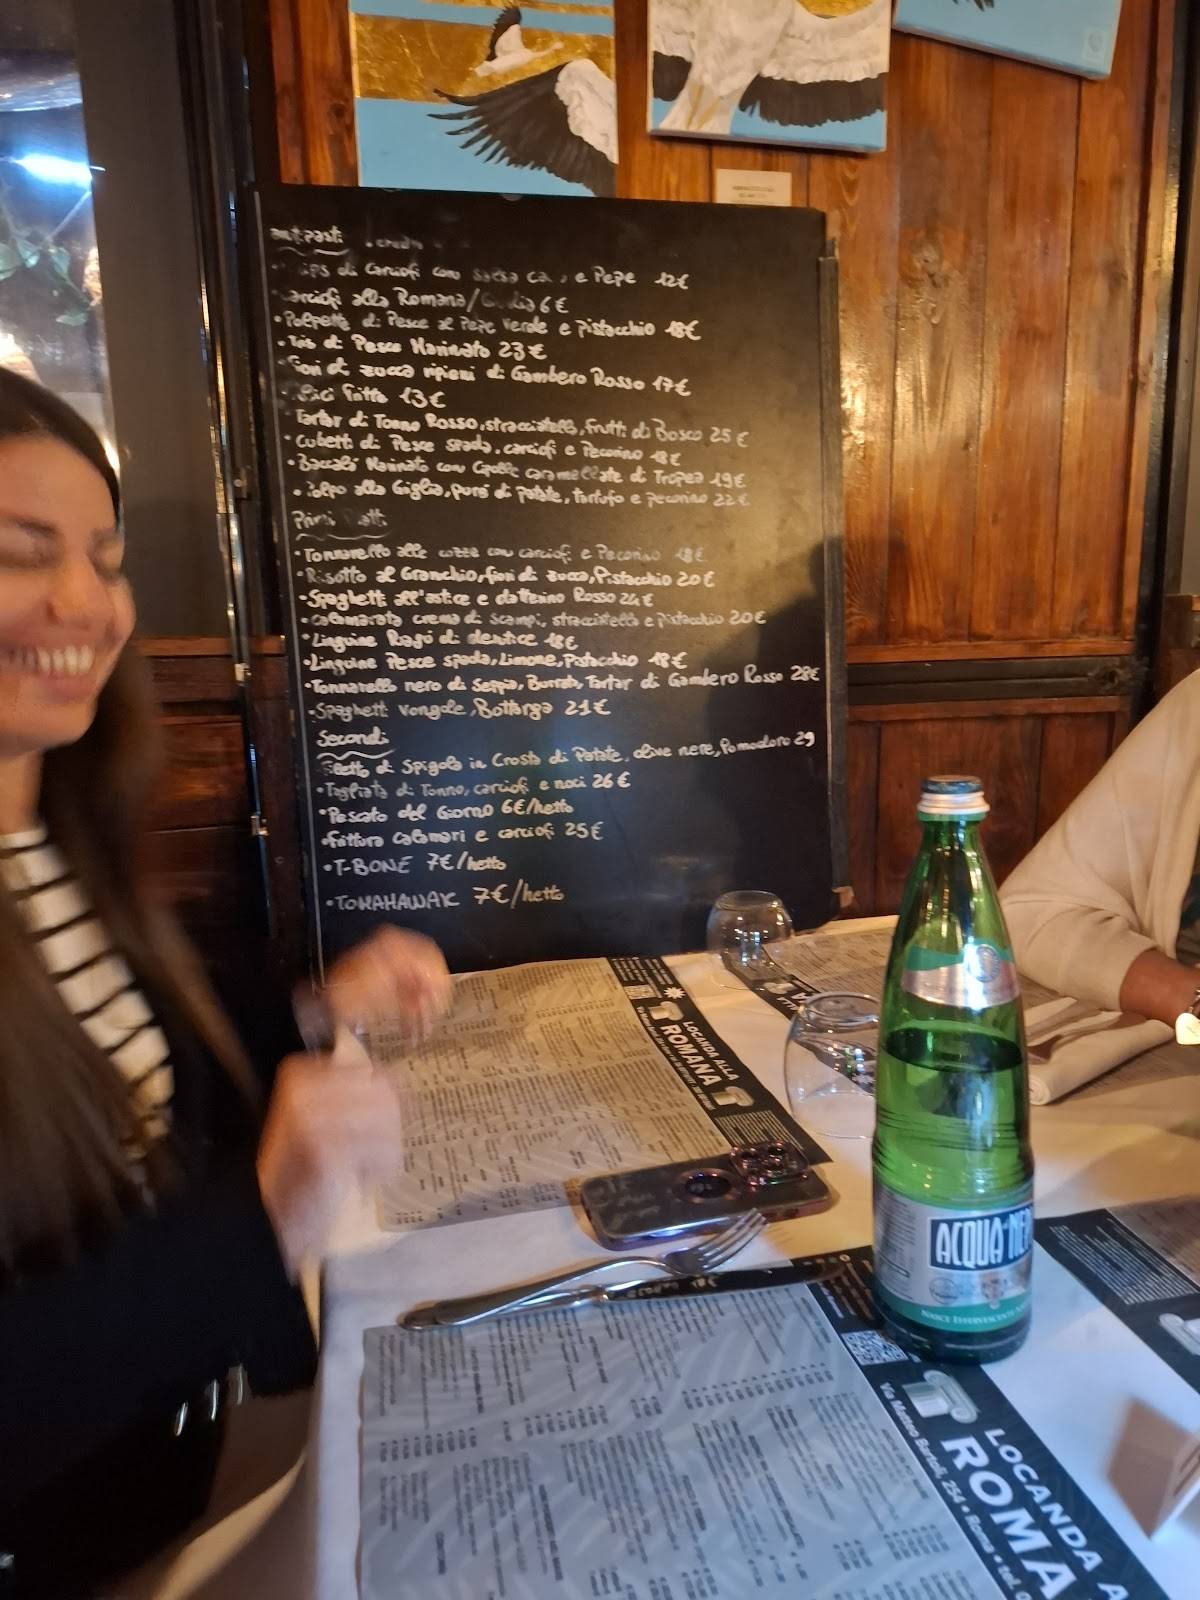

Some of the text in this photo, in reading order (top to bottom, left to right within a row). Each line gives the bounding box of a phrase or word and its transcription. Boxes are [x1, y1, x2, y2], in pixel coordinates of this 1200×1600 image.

[337, 263, 357, 276] di
[575, 272, 588, 283] e
[362, 313, 382, 328] di
[559, 322, 572, 336] e
[323, 334, 343, 349] di
[326, 356, 350, 376] di
[486, 363, 505, 379] di
[590, 367, 645, 389] Rosso
[349, 410, 368, 427] di
[631, 421, 650, 440] di
[360, 433, 381, 450] di
[564, 445, 577, 456] e
[630, 465, 647, 484] di
[494, 482, 512, 499] di
[630, 495, 641, 504] e
[580, 548, 592, 560] e
[305, 565, 367, 584] Risotto
[517, 565, 538, 582] di
[476, 592, 489, 606] e
[573, 587, 616, 604] Rosso
[464, 610, 482, 625] di
[644, 617, 655, 627] e
[438, 629, 461, 645] di
[404, 680, 442, 693] nero
[447, 676, 466, 691] di
[640, 674, 660, 689] di
[668, 668, 739, 688] Gambero
[744, 664, 784, 684] Rosso
[316, 726, 390, 747] Secondi
[376, 758, 395, 774] di
[469, 757, 488, 769] in
[549, 750, 569, 765] di
[396, 782, 415, 797] di
[539, 779, 550, 789] e
[554, 776, 587, 789] noci
[328, 807, 388, 824] Pescato
[397, 804, 427, 821] del
[475, 829, 489, 842] e
[660, 1024, 723, 1087] ROMANA
[683, 1021, 740, 1081] LOCANDA ALLA
[936, 1216, 1004, 1269] ACQUA
[984, 1428, 1104, 1572] LOCANDA
